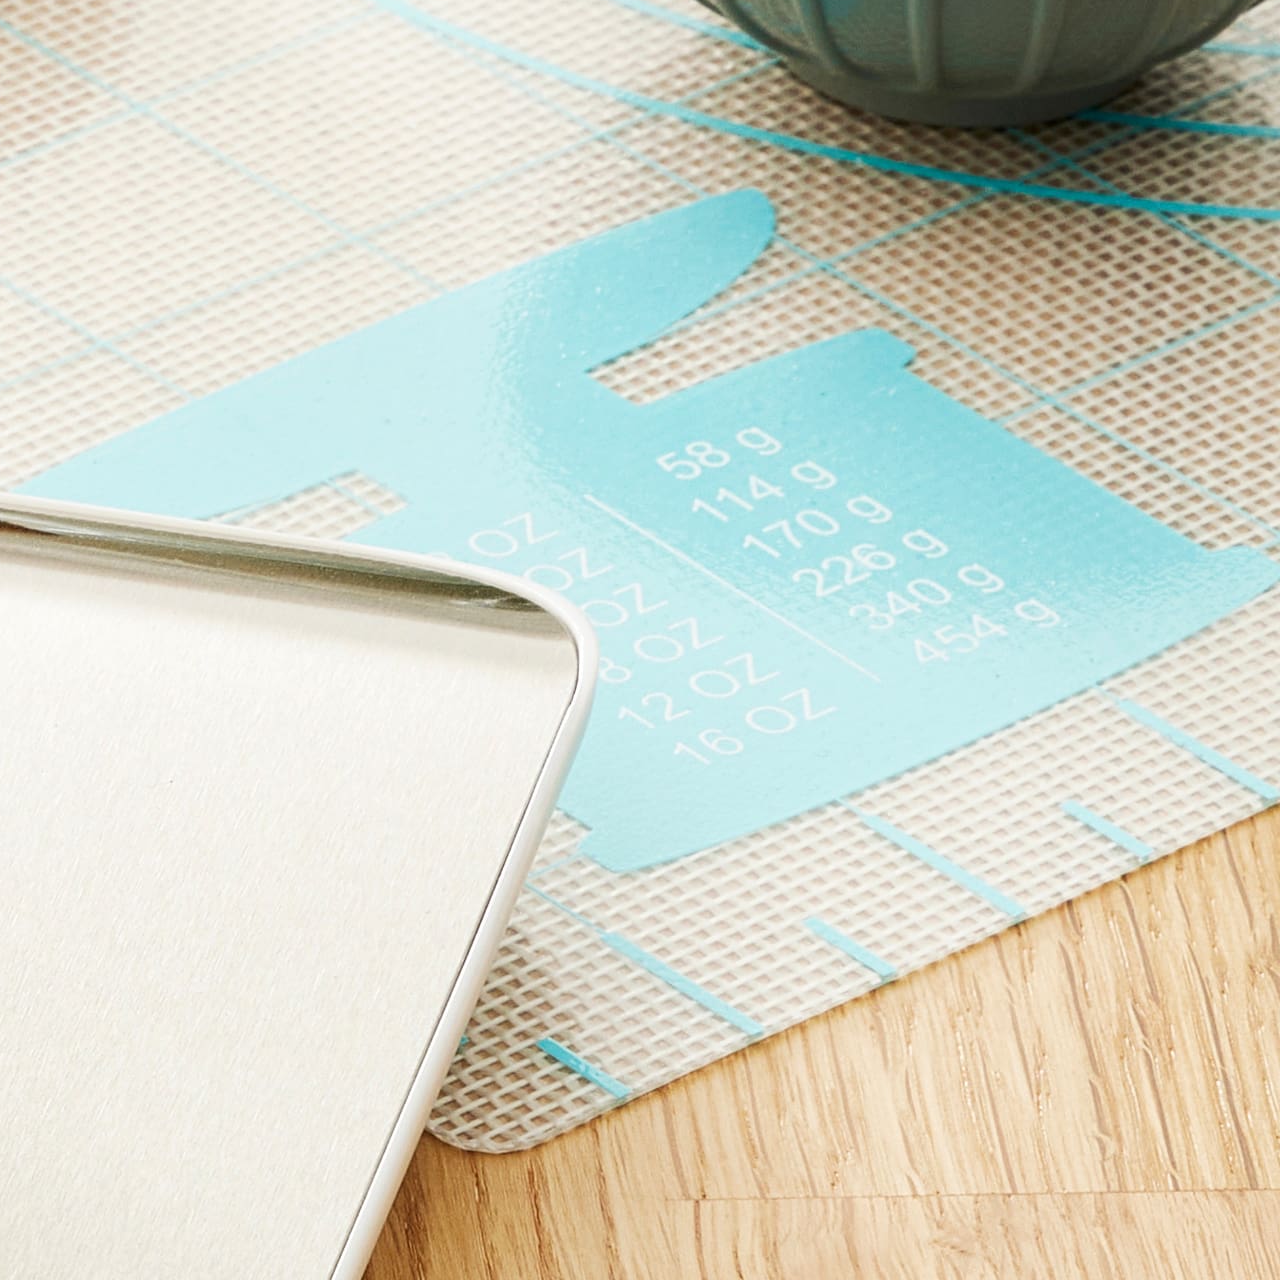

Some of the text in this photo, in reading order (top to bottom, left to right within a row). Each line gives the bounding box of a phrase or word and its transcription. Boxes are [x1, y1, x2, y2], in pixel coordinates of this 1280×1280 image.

[656, 426, 783, 480] 58 g
[691, 460, 838, 523] 114 g
[467, 511, 560, 558] OZ
[742, 495, 893, 559] 170 g
[523, 546, 615, 592] OZ
[791, 528, 950, 598] 226 g
[579, 582, 669, 626] OZ
[848, 563, 1005, 630] 340 g
[633, 616, 726, 663] OZ
[913, 598, 1061, 664] 454 g
[617, 652, 782, 729] 12 OZ
[673, 687, 838, 765] 16 OZ
